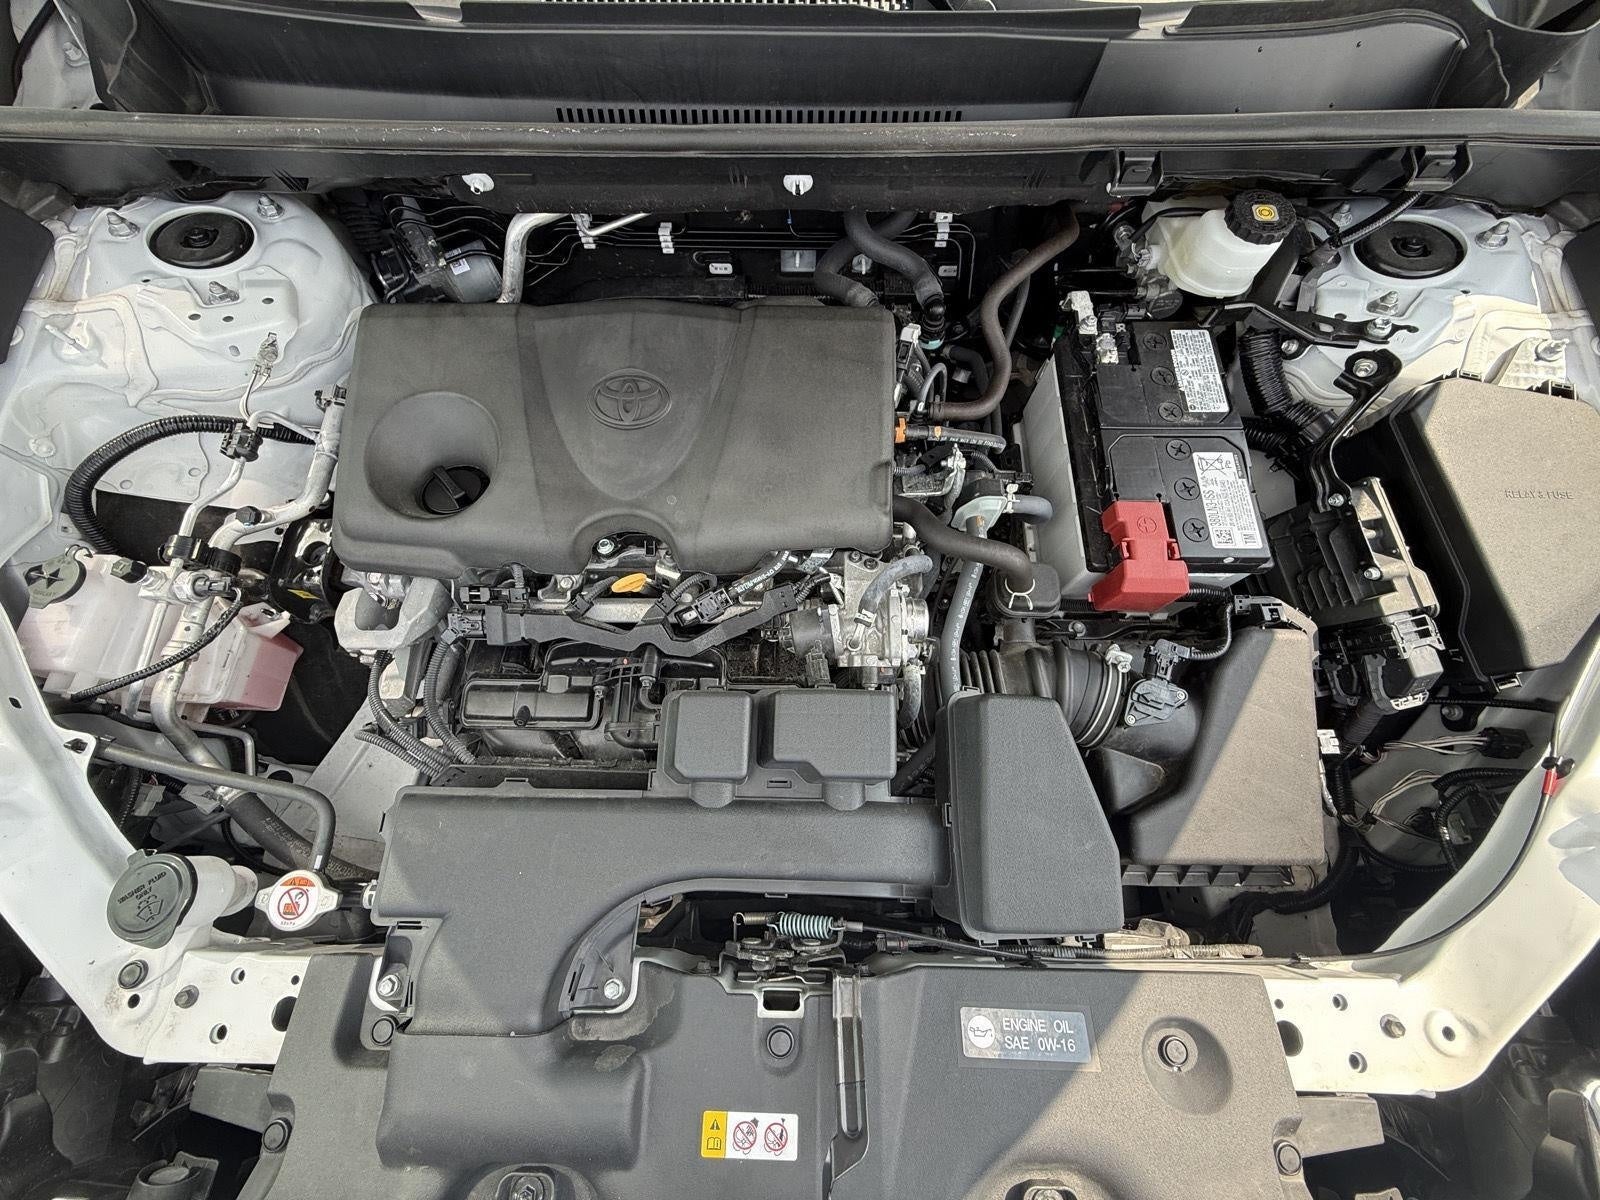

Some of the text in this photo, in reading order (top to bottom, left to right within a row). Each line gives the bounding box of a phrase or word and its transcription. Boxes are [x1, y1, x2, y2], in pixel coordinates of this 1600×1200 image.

[1503, 489, 1536, 499] RELAY
[1546, 490, 1575, 500] FUSE
[117, 871, 167, 904] WASHER FLUID
[135, 886, 152, 900] ONLY
[1002, 1017, 1075, 1034] ENGINE OIL
[1004, 1035, 1076, 1052] SAE 0W-16
